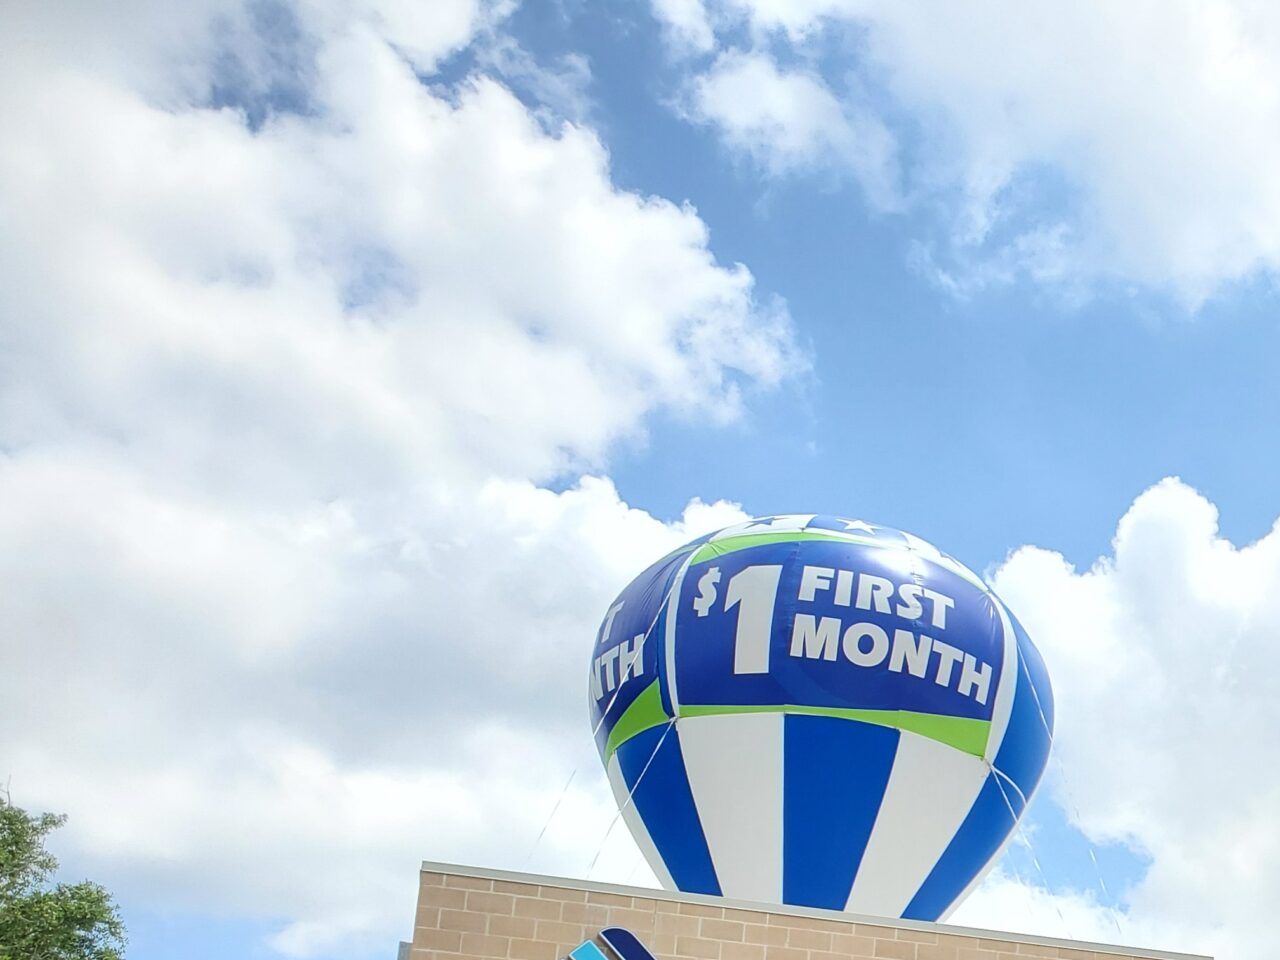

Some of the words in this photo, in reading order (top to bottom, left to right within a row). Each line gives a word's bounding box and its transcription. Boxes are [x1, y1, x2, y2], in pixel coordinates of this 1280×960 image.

[693, 564, 784, 675] $1
[797, 565, 955, 630] FIRST
[789, 613, 993, 706] MONTH
